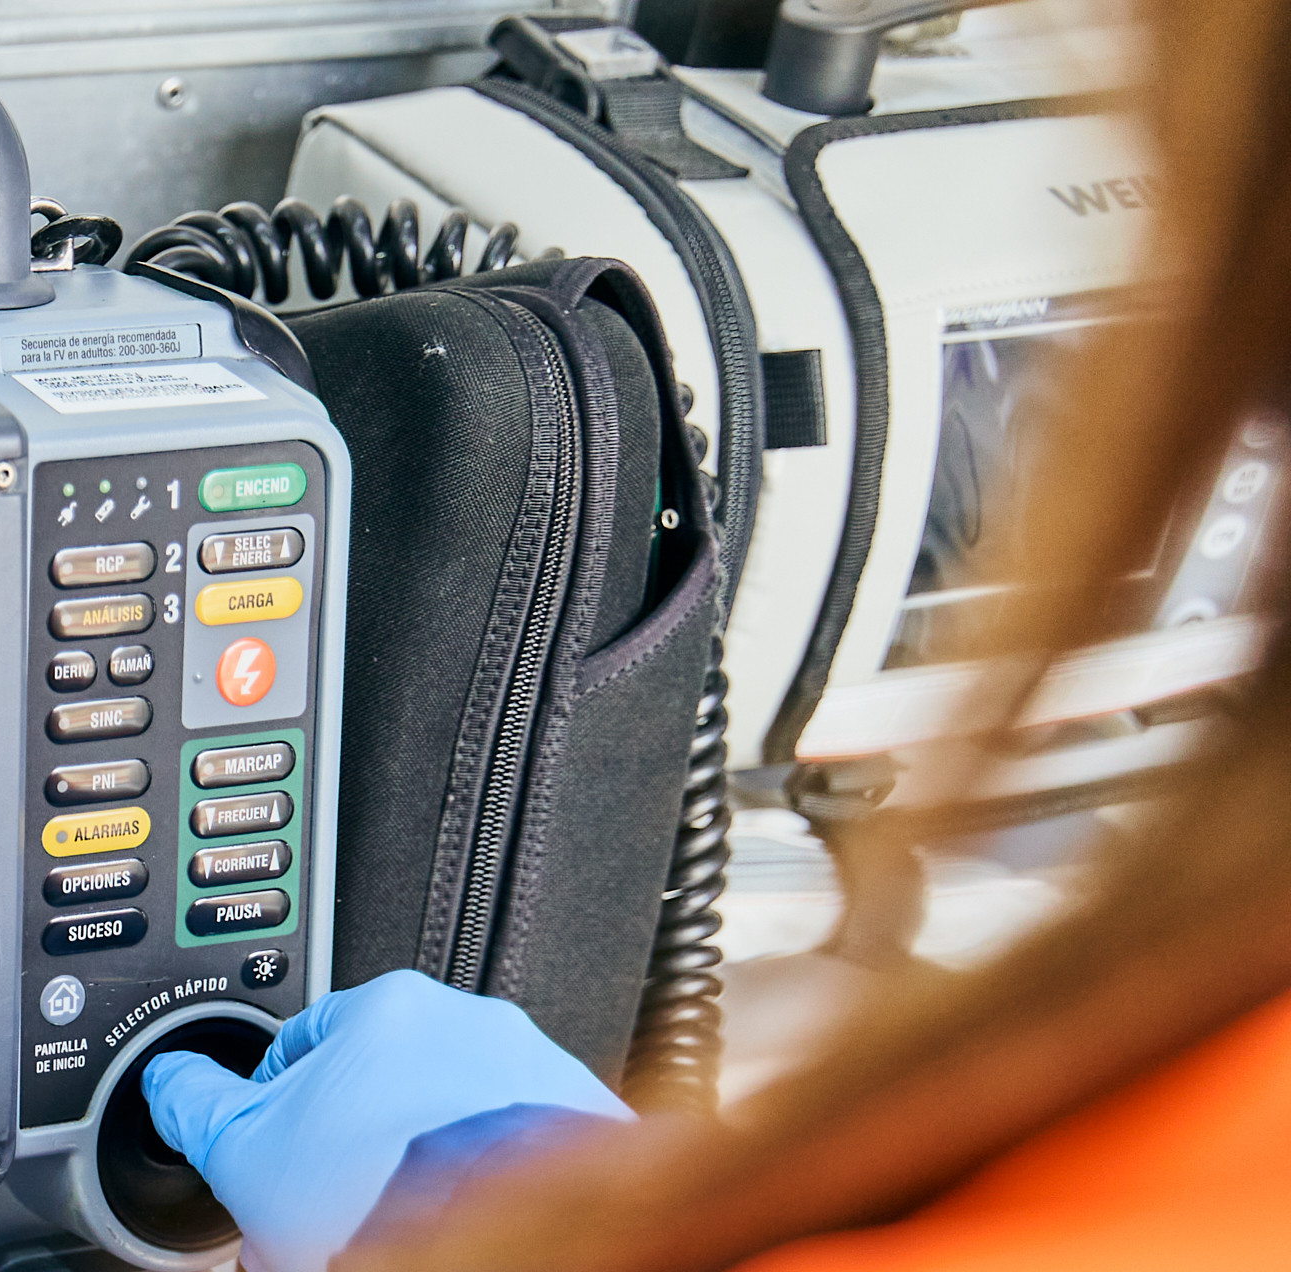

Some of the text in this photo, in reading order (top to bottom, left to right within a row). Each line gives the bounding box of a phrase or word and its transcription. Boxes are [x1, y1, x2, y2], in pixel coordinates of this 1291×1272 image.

[21, 329, 177, 351] Secuencia de energía recomendada
[21, 341, 181, 365] para la FV en adultos: 200-300-360J
[167, 478, 180, 510] 1
[235, 477, 291, 497] ENCEND
[234, 535, 271, 552] SELEC
[96, 556, 125, 574] RCP
[165, 542, 182, 573] 2
[232, 549, 272, 566] ENERG
[163, 594, 180, 624] 3
[228, 592, 275, 611] CARGA
[82, 604, 144, 626] ANÁLISIS
[54, 662, 91, 680] DERIV
[112, 654, 151, 675] TAMAÑ
[90, 711, 123, 728] SINC
[224, 753, 282, 775] MARCAP
[92, 774, 116, 791] PNI
[218, 806, 268, 824] FRECUEN
[74, 820, 140, 843] ALARMAS
[214, 854, 269, 874] CORRNTE
[62, 871, 131, 894] OPCIONES
[216, 903, 262, 923] PAUSA
[68, 920, 123, 942] SUCESO
[105, 977, 228, 1047] SELECTOR RÁPIDO
[34, 1038, 88, 1057] PANTALLA
[36, 1055, 86, 1073] DE INICIO
